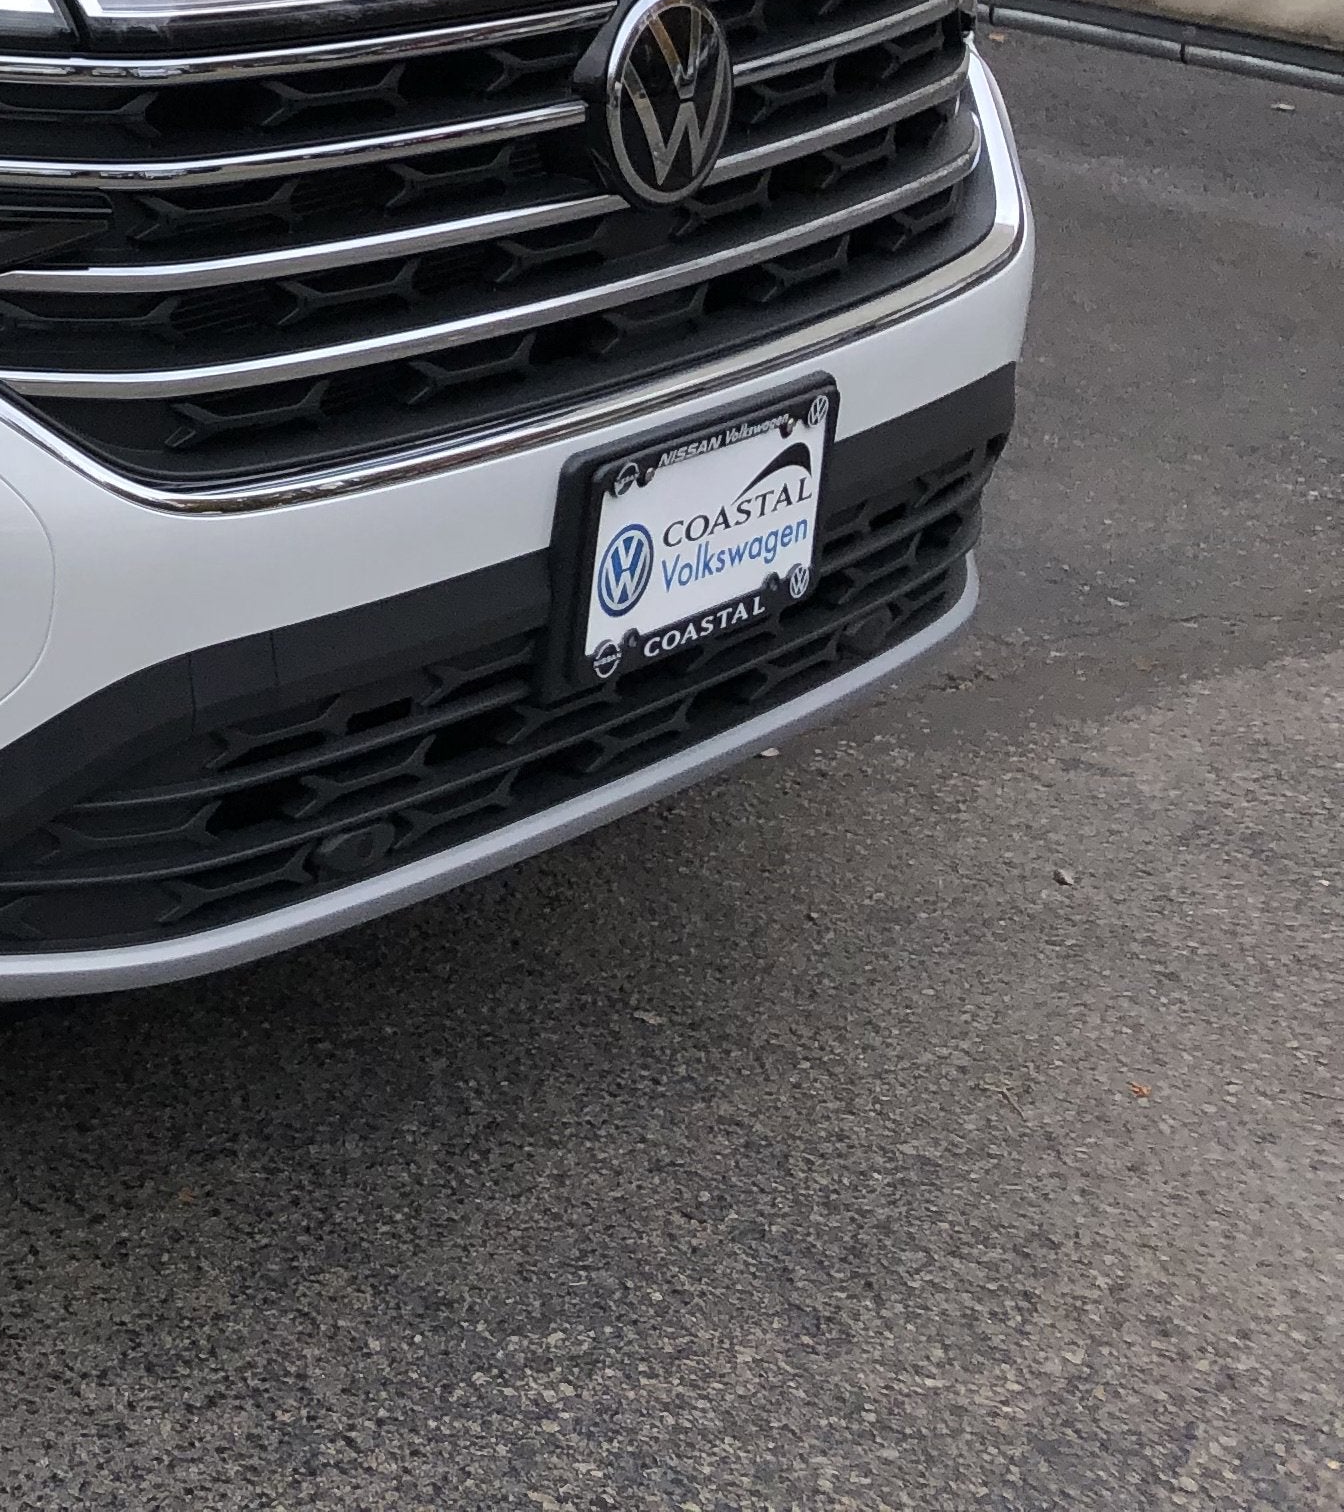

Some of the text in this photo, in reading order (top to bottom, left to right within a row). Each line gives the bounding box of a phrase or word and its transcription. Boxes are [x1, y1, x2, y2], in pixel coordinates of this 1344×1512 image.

[658, 434, 723, 467] NISSAN
[662, 476, 814, 548] COASTAL
[661, 518, 809, 593] Volkswagen
[643, 595, 766, 658] COASTAL
